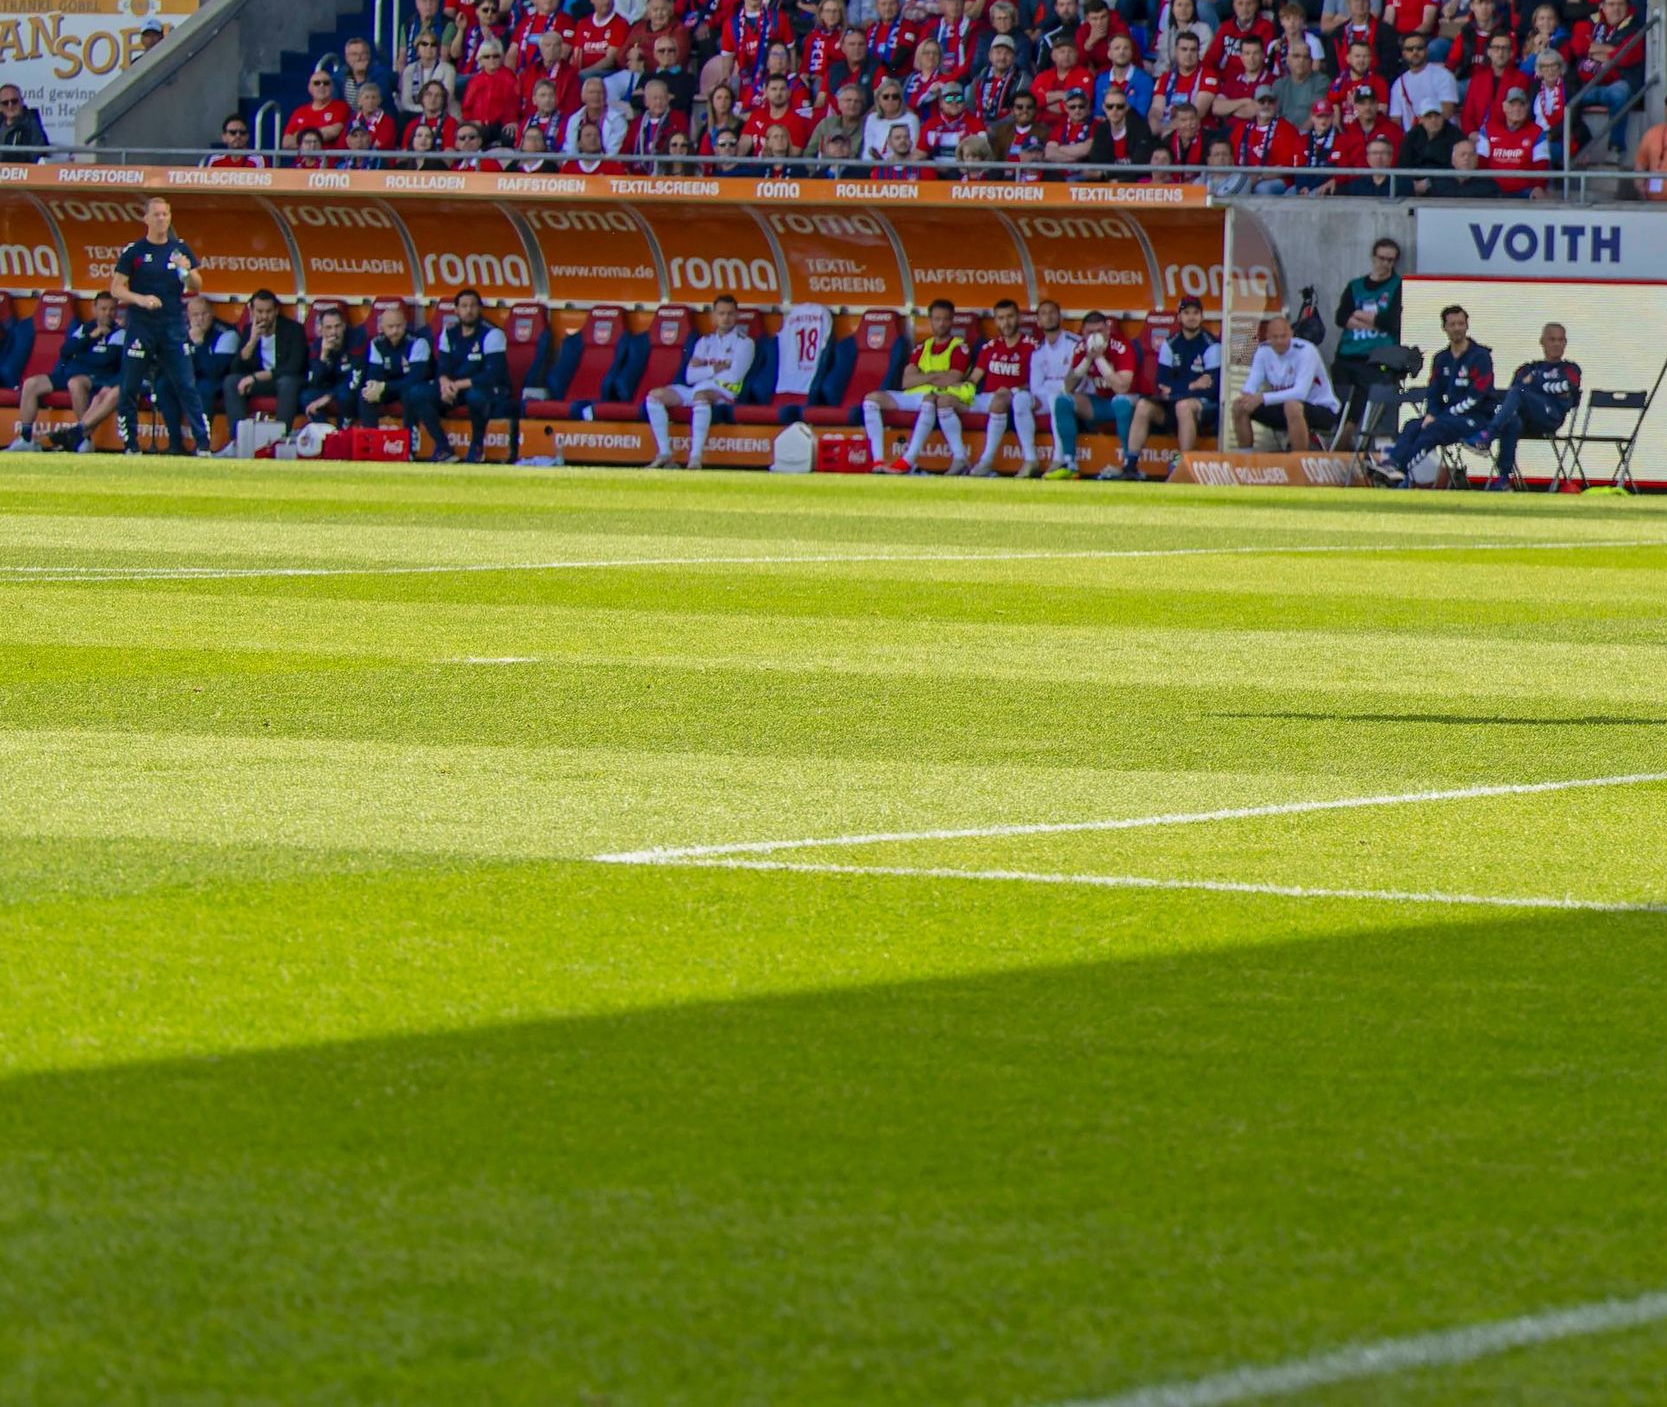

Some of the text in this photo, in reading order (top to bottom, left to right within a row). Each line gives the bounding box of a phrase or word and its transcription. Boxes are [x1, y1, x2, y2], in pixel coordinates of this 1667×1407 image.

[58, 169, 144, 184] RAFFSTOREN
[168, 171, 272, 187] TEXTILSCREENS
[309, 173, 350, 189] roma
[385, 174, 465, 190] ROLLLADEN
[497, 176, 586, 193] RAFFSTOREN
[611, 179, 719, 196] TEXTILSCREENS
[757, 181, 799, 198] roma
[836, 183, 918, 199] ROLLLADEN
[951, 185, 1043, 202] RAFFSTOREN
[1069, 186, 1183, 204] TEXTILSCREENS
[528, 207, 639, 233] roma
[767, 210, 882, 237] roma
[1017, 214, 1133, 240] roma
[1469, 223, 1621, 263] VOITH
[198, 256, 290, 272] AFFSTOREN
[311, 258, 404, 275] ROLLLADEN
[424, 251, 529, 288] roma
[551, 264, 654, 280] www.roma.de
[670, 257, 778, 292] roma
[806, 258, 867, 274] TEXTIL-
[914, 268, 1023, 285] RAFFSTOREN
[810, 277, 885, 293] SCREENS
[1043, 270, 1142, 286] ROLLLADEN
[1164, 263, 1275, 298] roma
[794, 328, 819, 362] 18
